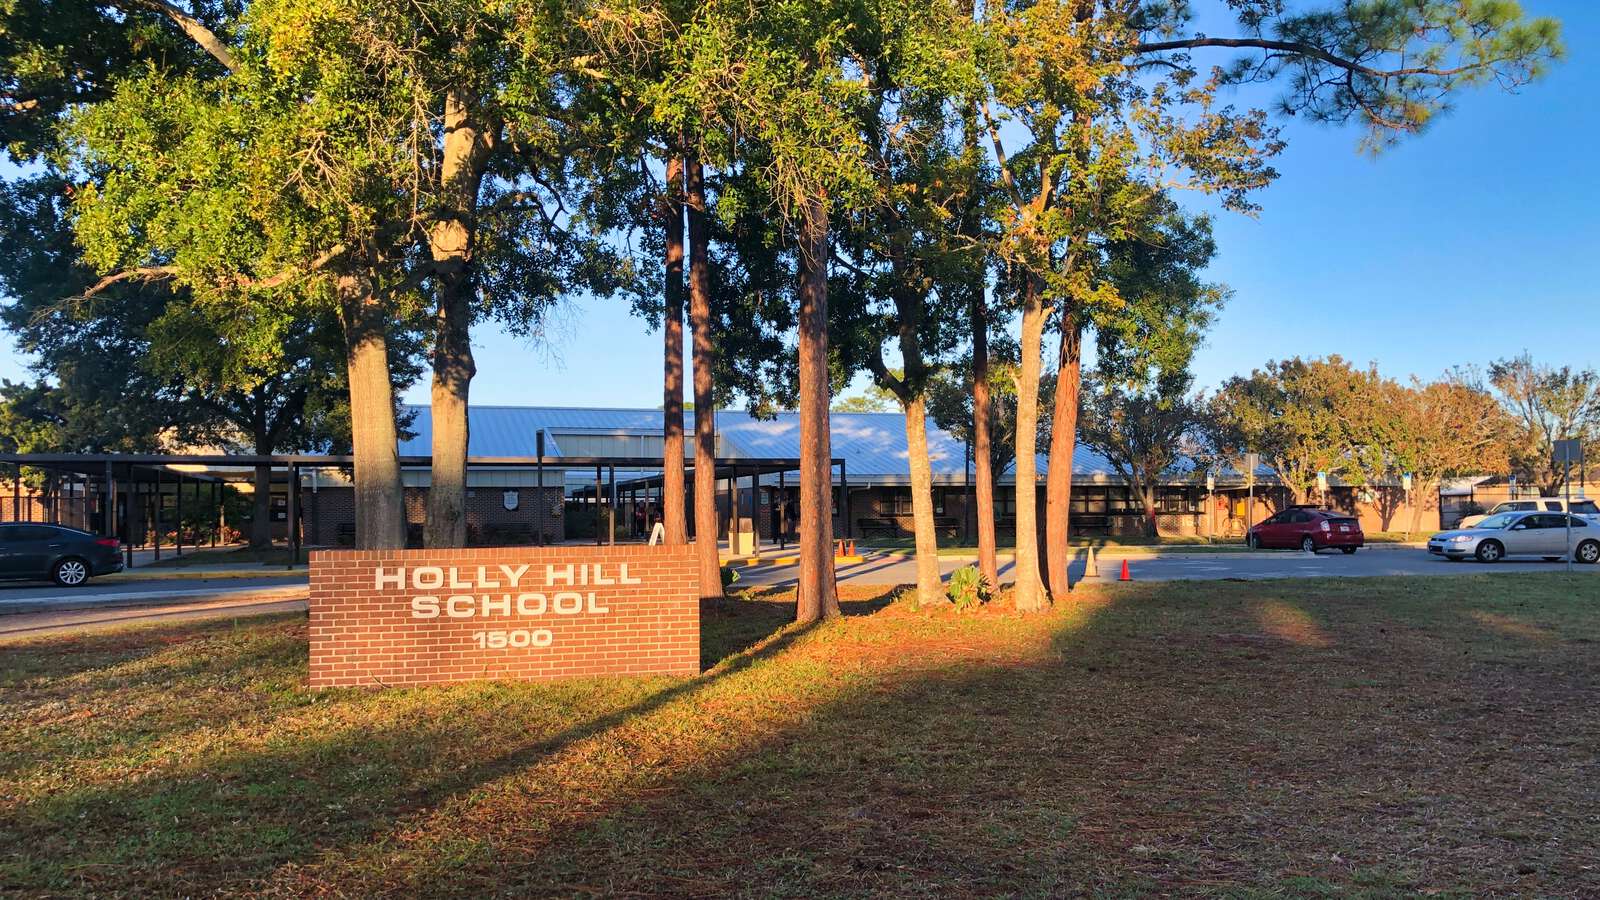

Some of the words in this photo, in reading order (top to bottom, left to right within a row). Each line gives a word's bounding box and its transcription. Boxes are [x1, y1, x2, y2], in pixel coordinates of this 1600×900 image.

[375, 565, 530, 590] HOLLY
[546, 563, 641, 586] HILL
[411, 592, 609, 618] SCHOOL
[472, 630, 553, 649] 1500
